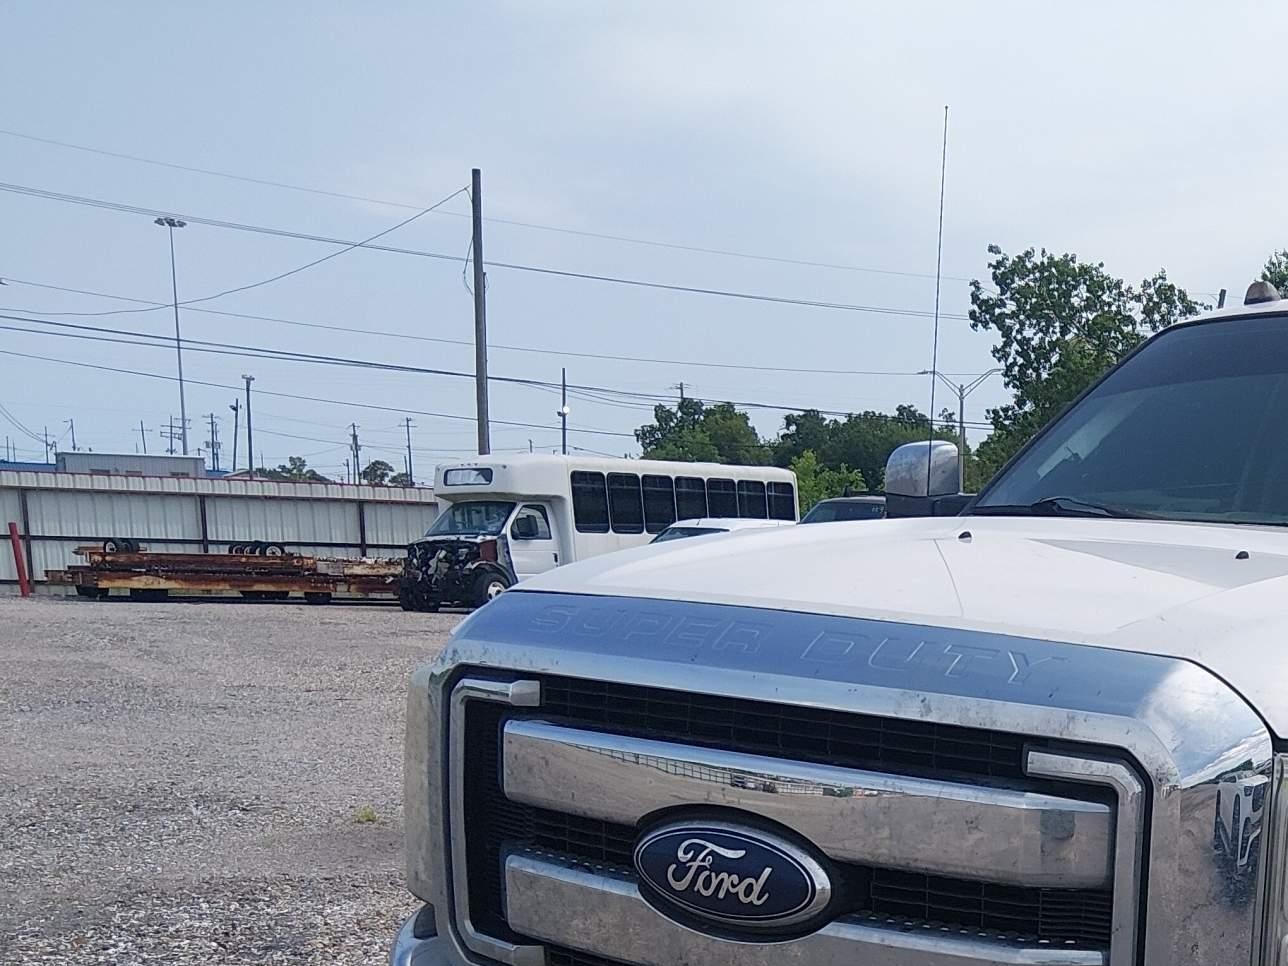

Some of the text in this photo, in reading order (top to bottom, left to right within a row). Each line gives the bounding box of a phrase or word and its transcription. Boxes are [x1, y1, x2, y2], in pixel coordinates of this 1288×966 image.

[528, 604, 1068, 685] SUPER DUTY
[667, 838, 773, 906] Ford
